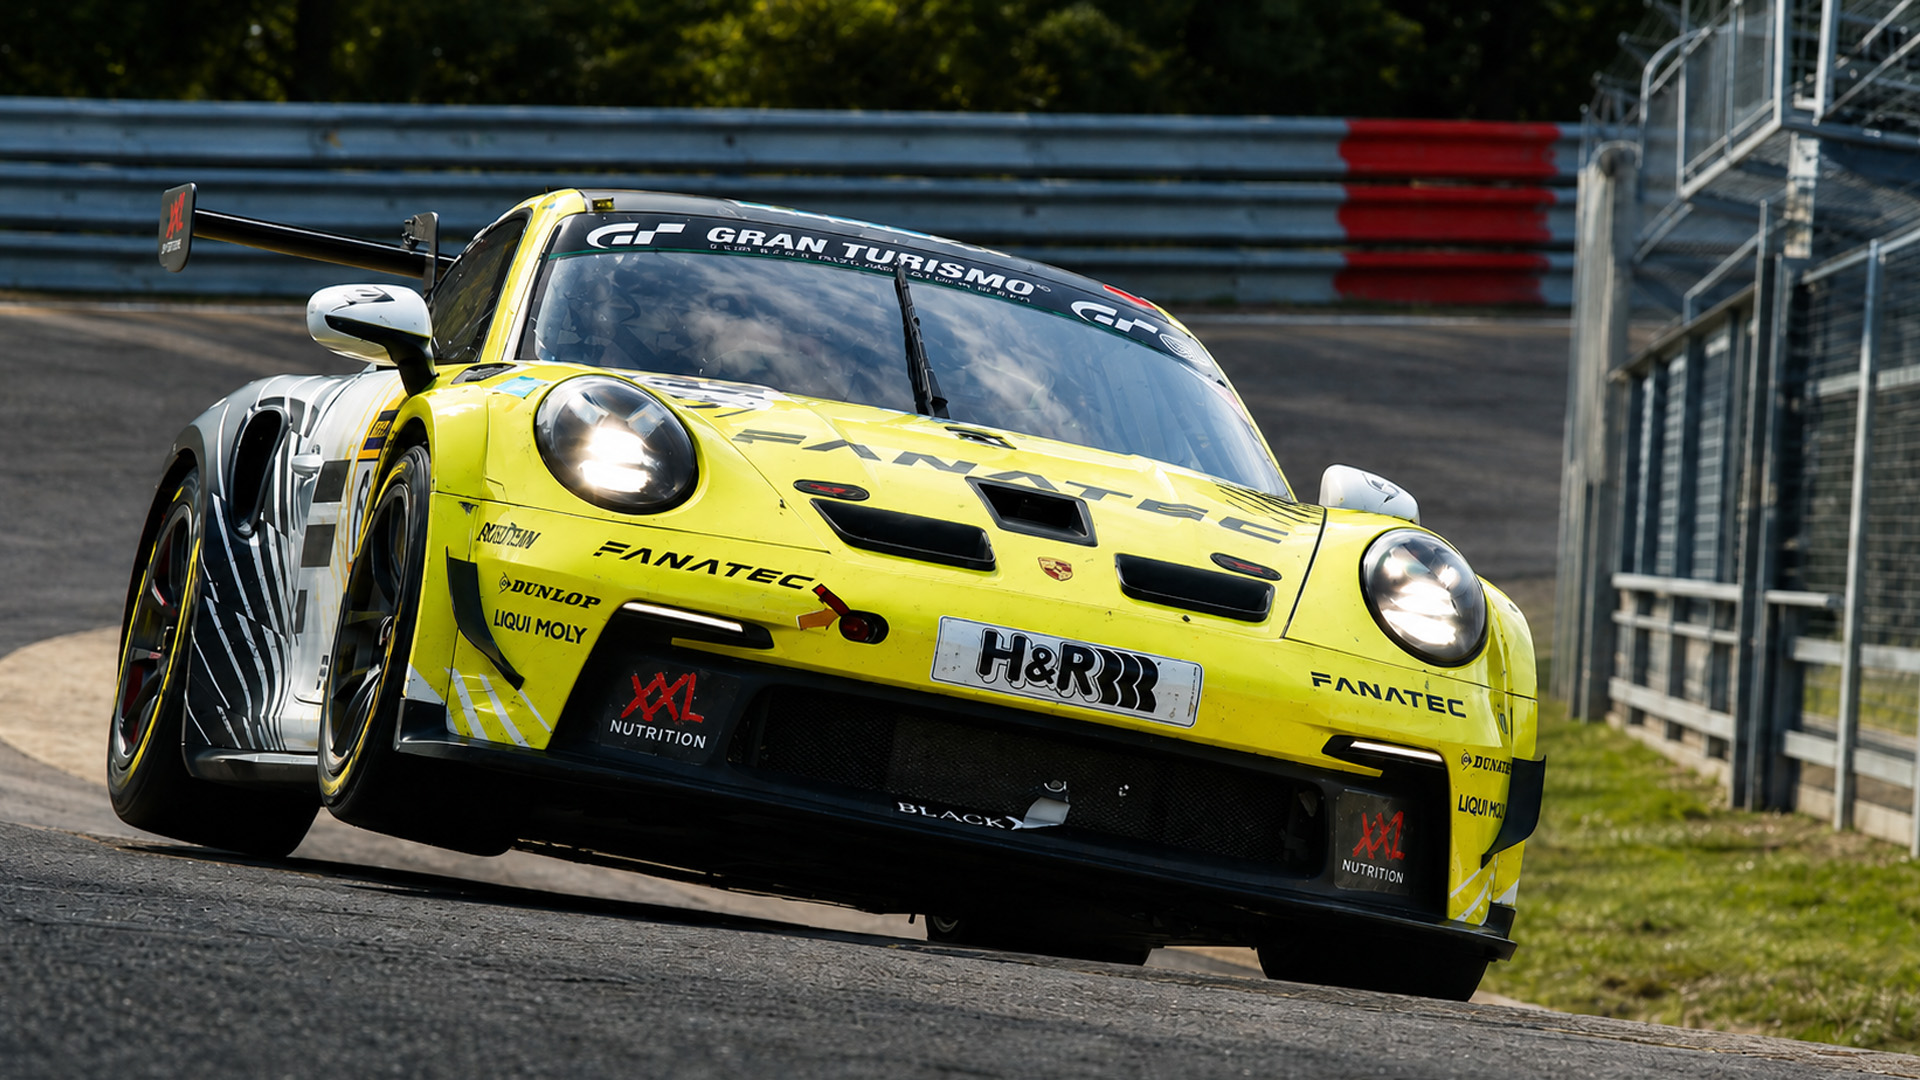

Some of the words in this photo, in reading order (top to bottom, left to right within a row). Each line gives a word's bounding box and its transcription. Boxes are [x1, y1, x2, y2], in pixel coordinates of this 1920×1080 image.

[706, 227, 828, 253] GRAN
[842, 242, 1035, 296] TURISMO
[592, 540, 815, 590] FANATEC
[510, 579, 602, 609] DUNLOP
[493, 609, 531, 633] LIQUI
[534, 618, 588, 644] MOLY
[976, 628, 1102, 703] H&R
[620, 671, 705, 724] XXL
[1310, 671, 1467, 719] FANATEC
[609, 719, 707, 749] NUTRITION
[897, 801, 1006, 829] BLACK
[1457, 794, 1489, 816] LIQUI
[1351, 810, 1406, 861] XXL
[1342, 859, 1404, 884] NUTRITION
